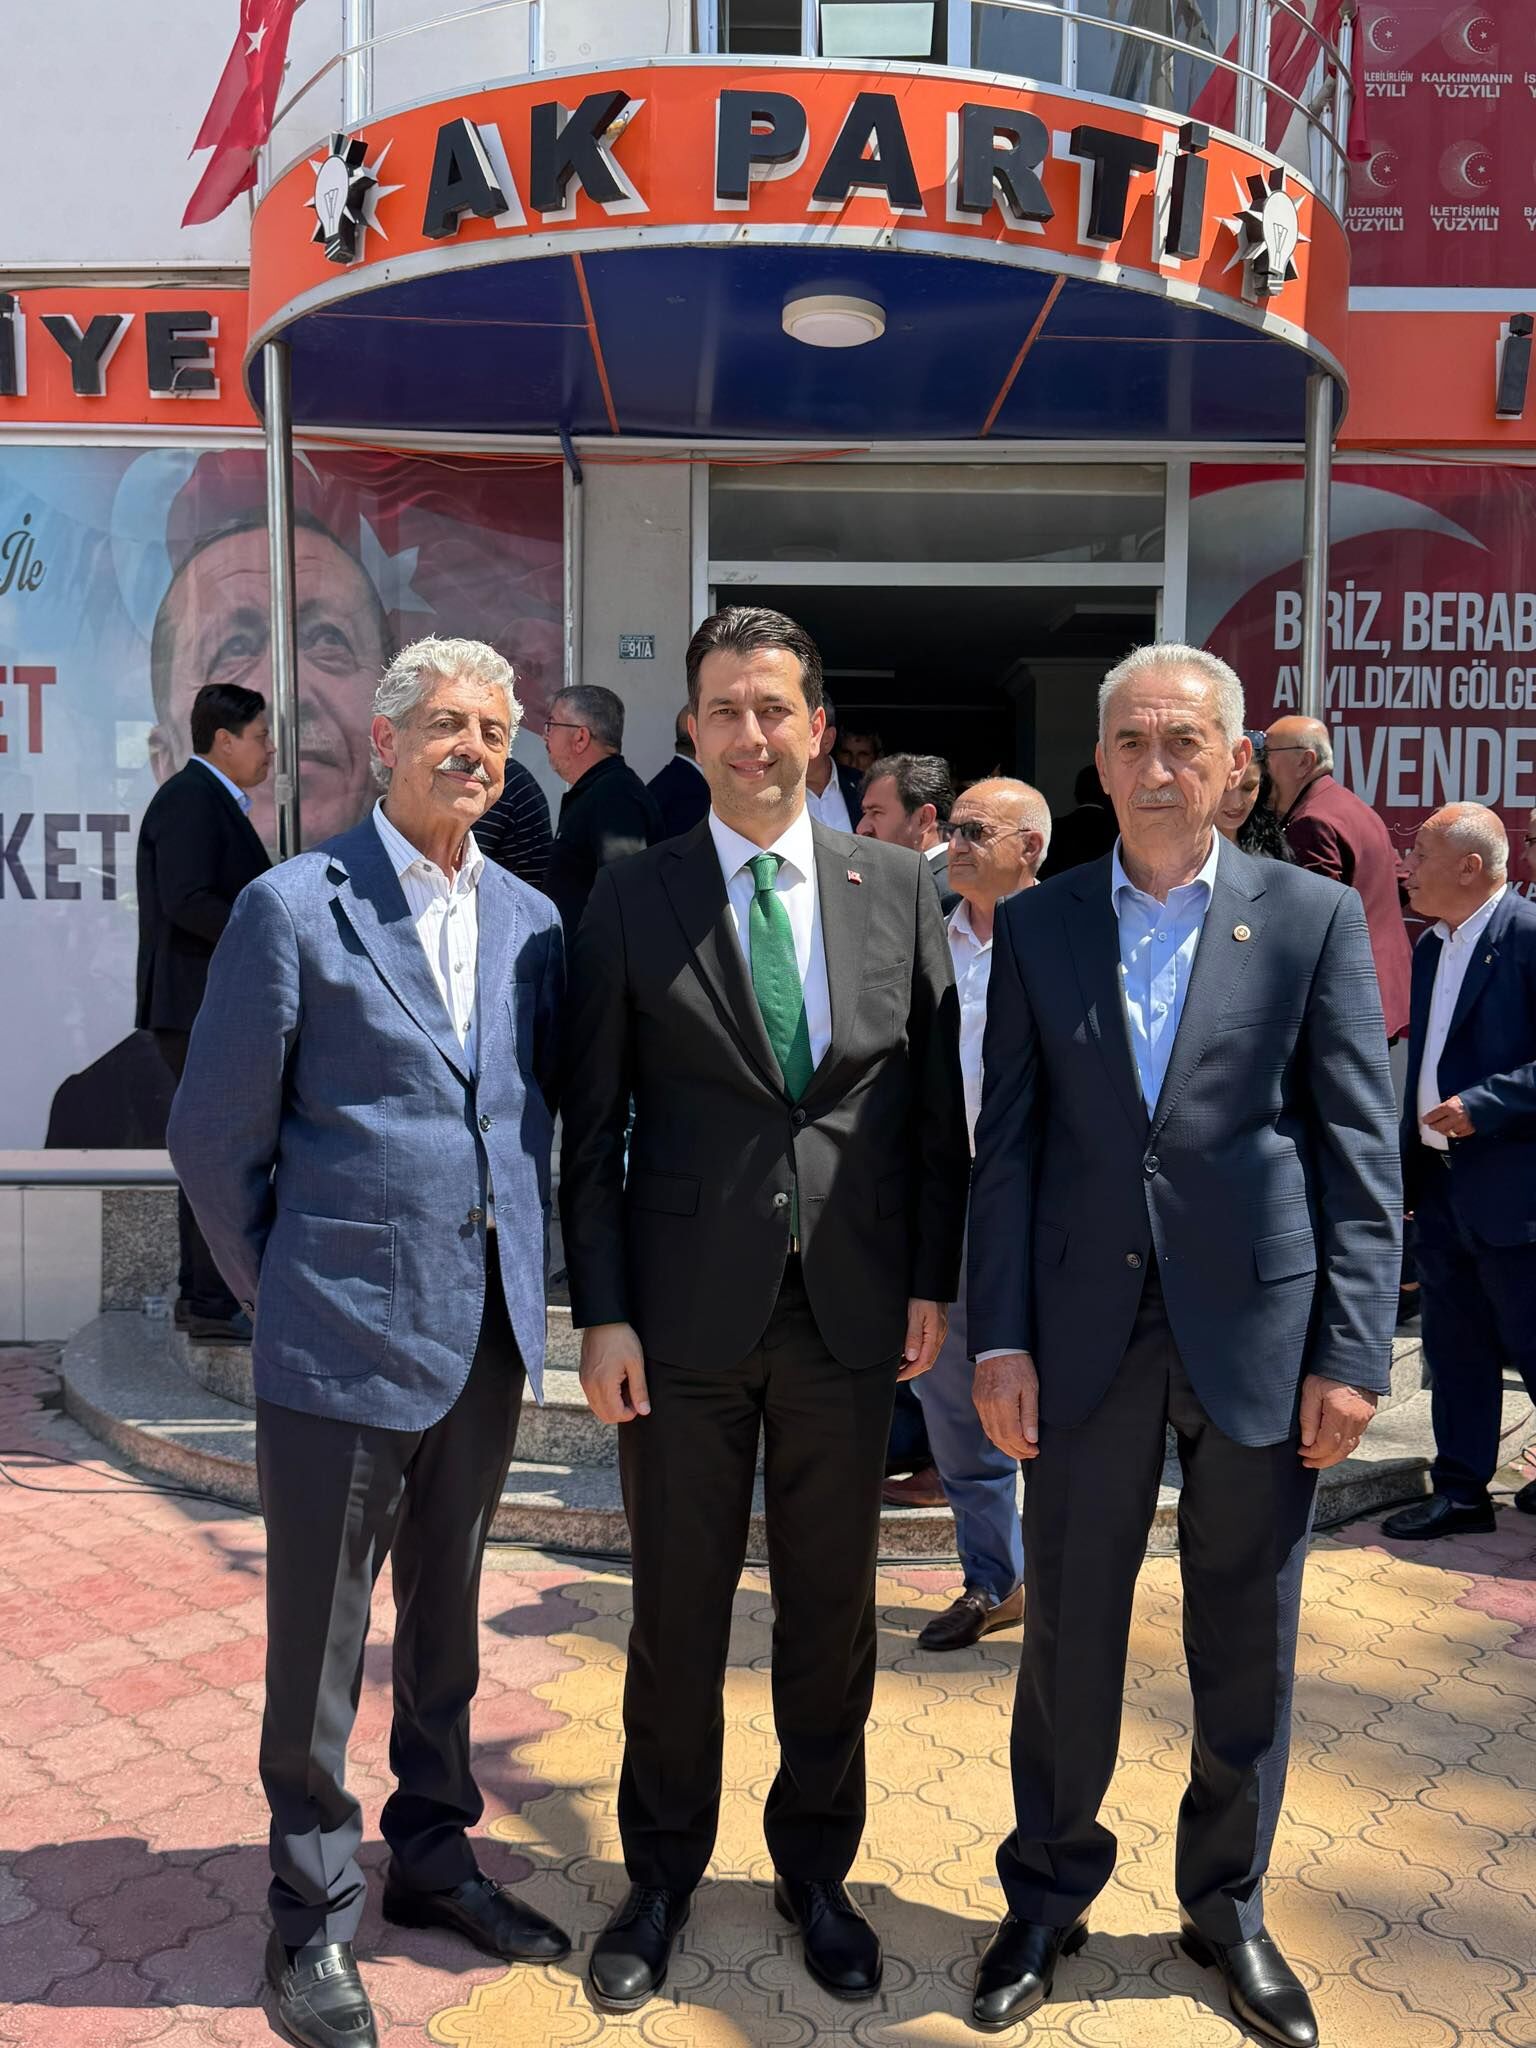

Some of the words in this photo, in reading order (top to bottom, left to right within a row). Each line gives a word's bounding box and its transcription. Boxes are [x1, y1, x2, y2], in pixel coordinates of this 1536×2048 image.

[1421, 72, 1513, 84] KALKINMANIN
[1435, 84, 1500, 98] YÜZYILI
[422, 89, 648, 240] AK
[715, 89, 1209, 265] PARTİ
[1345, 206, 1403, 217] UZURUN
[1430, 204, 1500, 218] İLETİŞİMİN
[1432, 217, 1499, 232] YÜZYILI
[1274, 580, 1391, 659] BRİZ,
[1402, 591, 1536, 652] BERAB
[1449, 659, 1536, 711] GÖLGE
